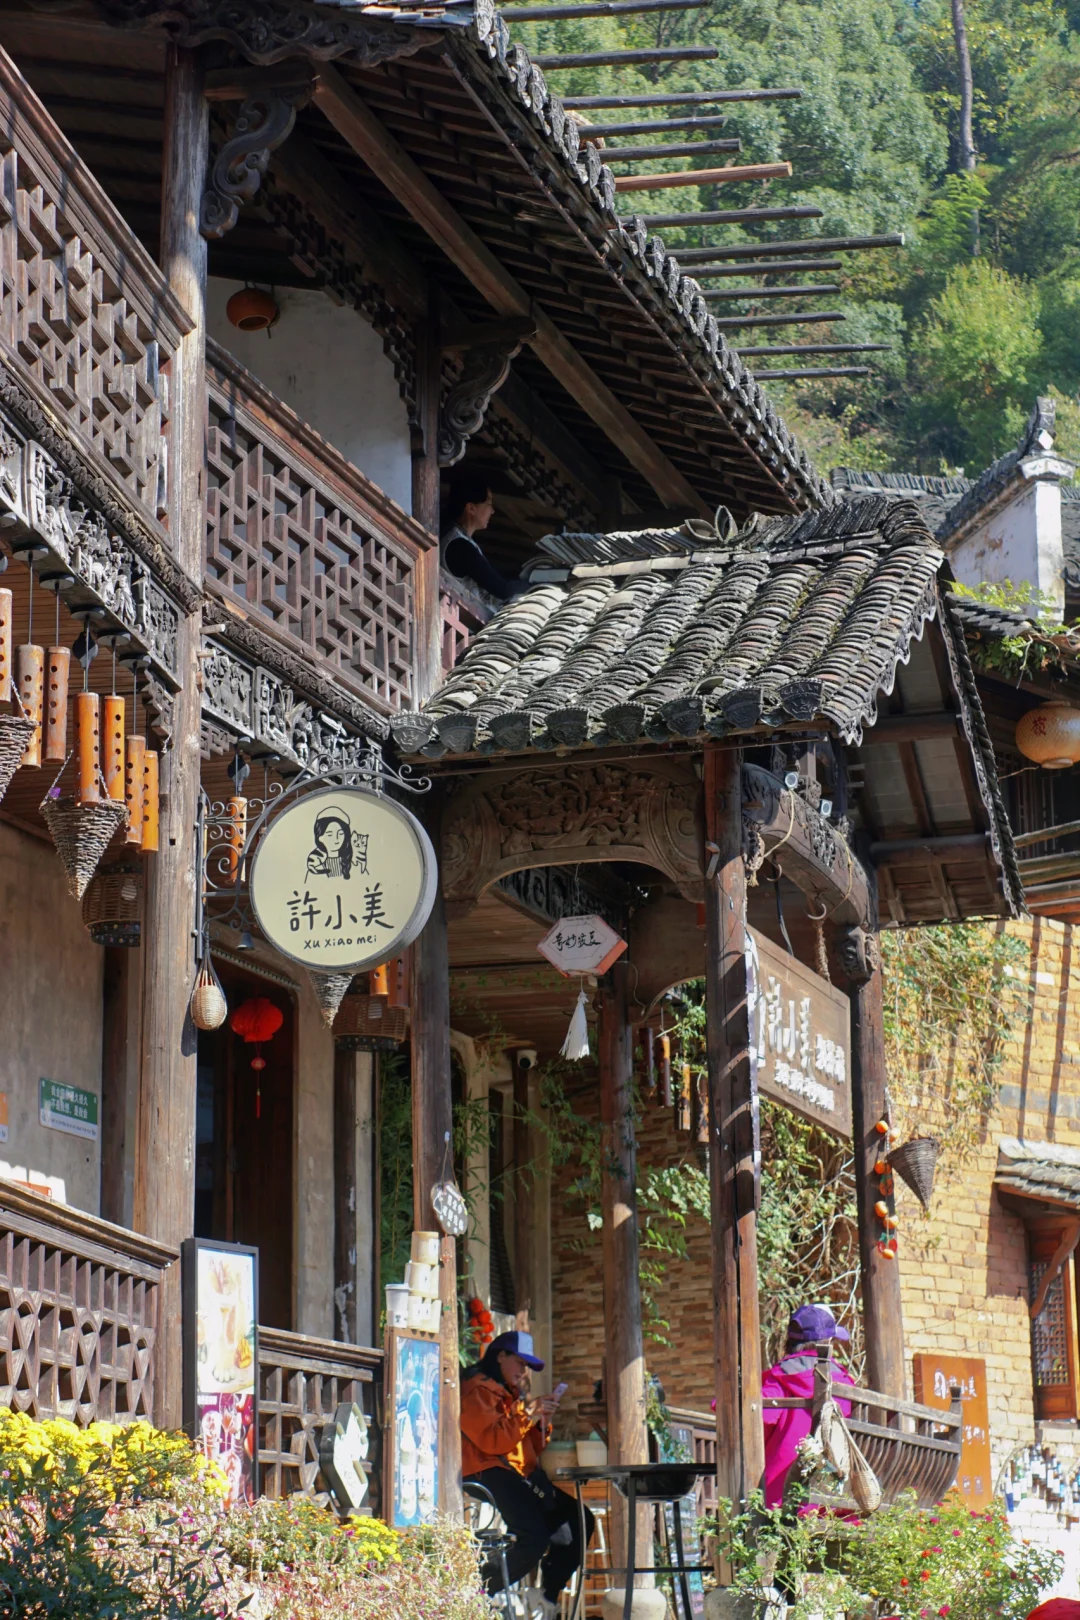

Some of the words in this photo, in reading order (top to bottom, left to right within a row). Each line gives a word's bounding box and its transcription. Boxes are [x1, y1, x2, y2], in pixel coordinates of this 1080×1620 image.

[286, 882, 395, 932] 許小美
[303, 939, 320, 950] xu
[325, 937, 353, 947] xiao
[357, 935, 377, 945] mei
